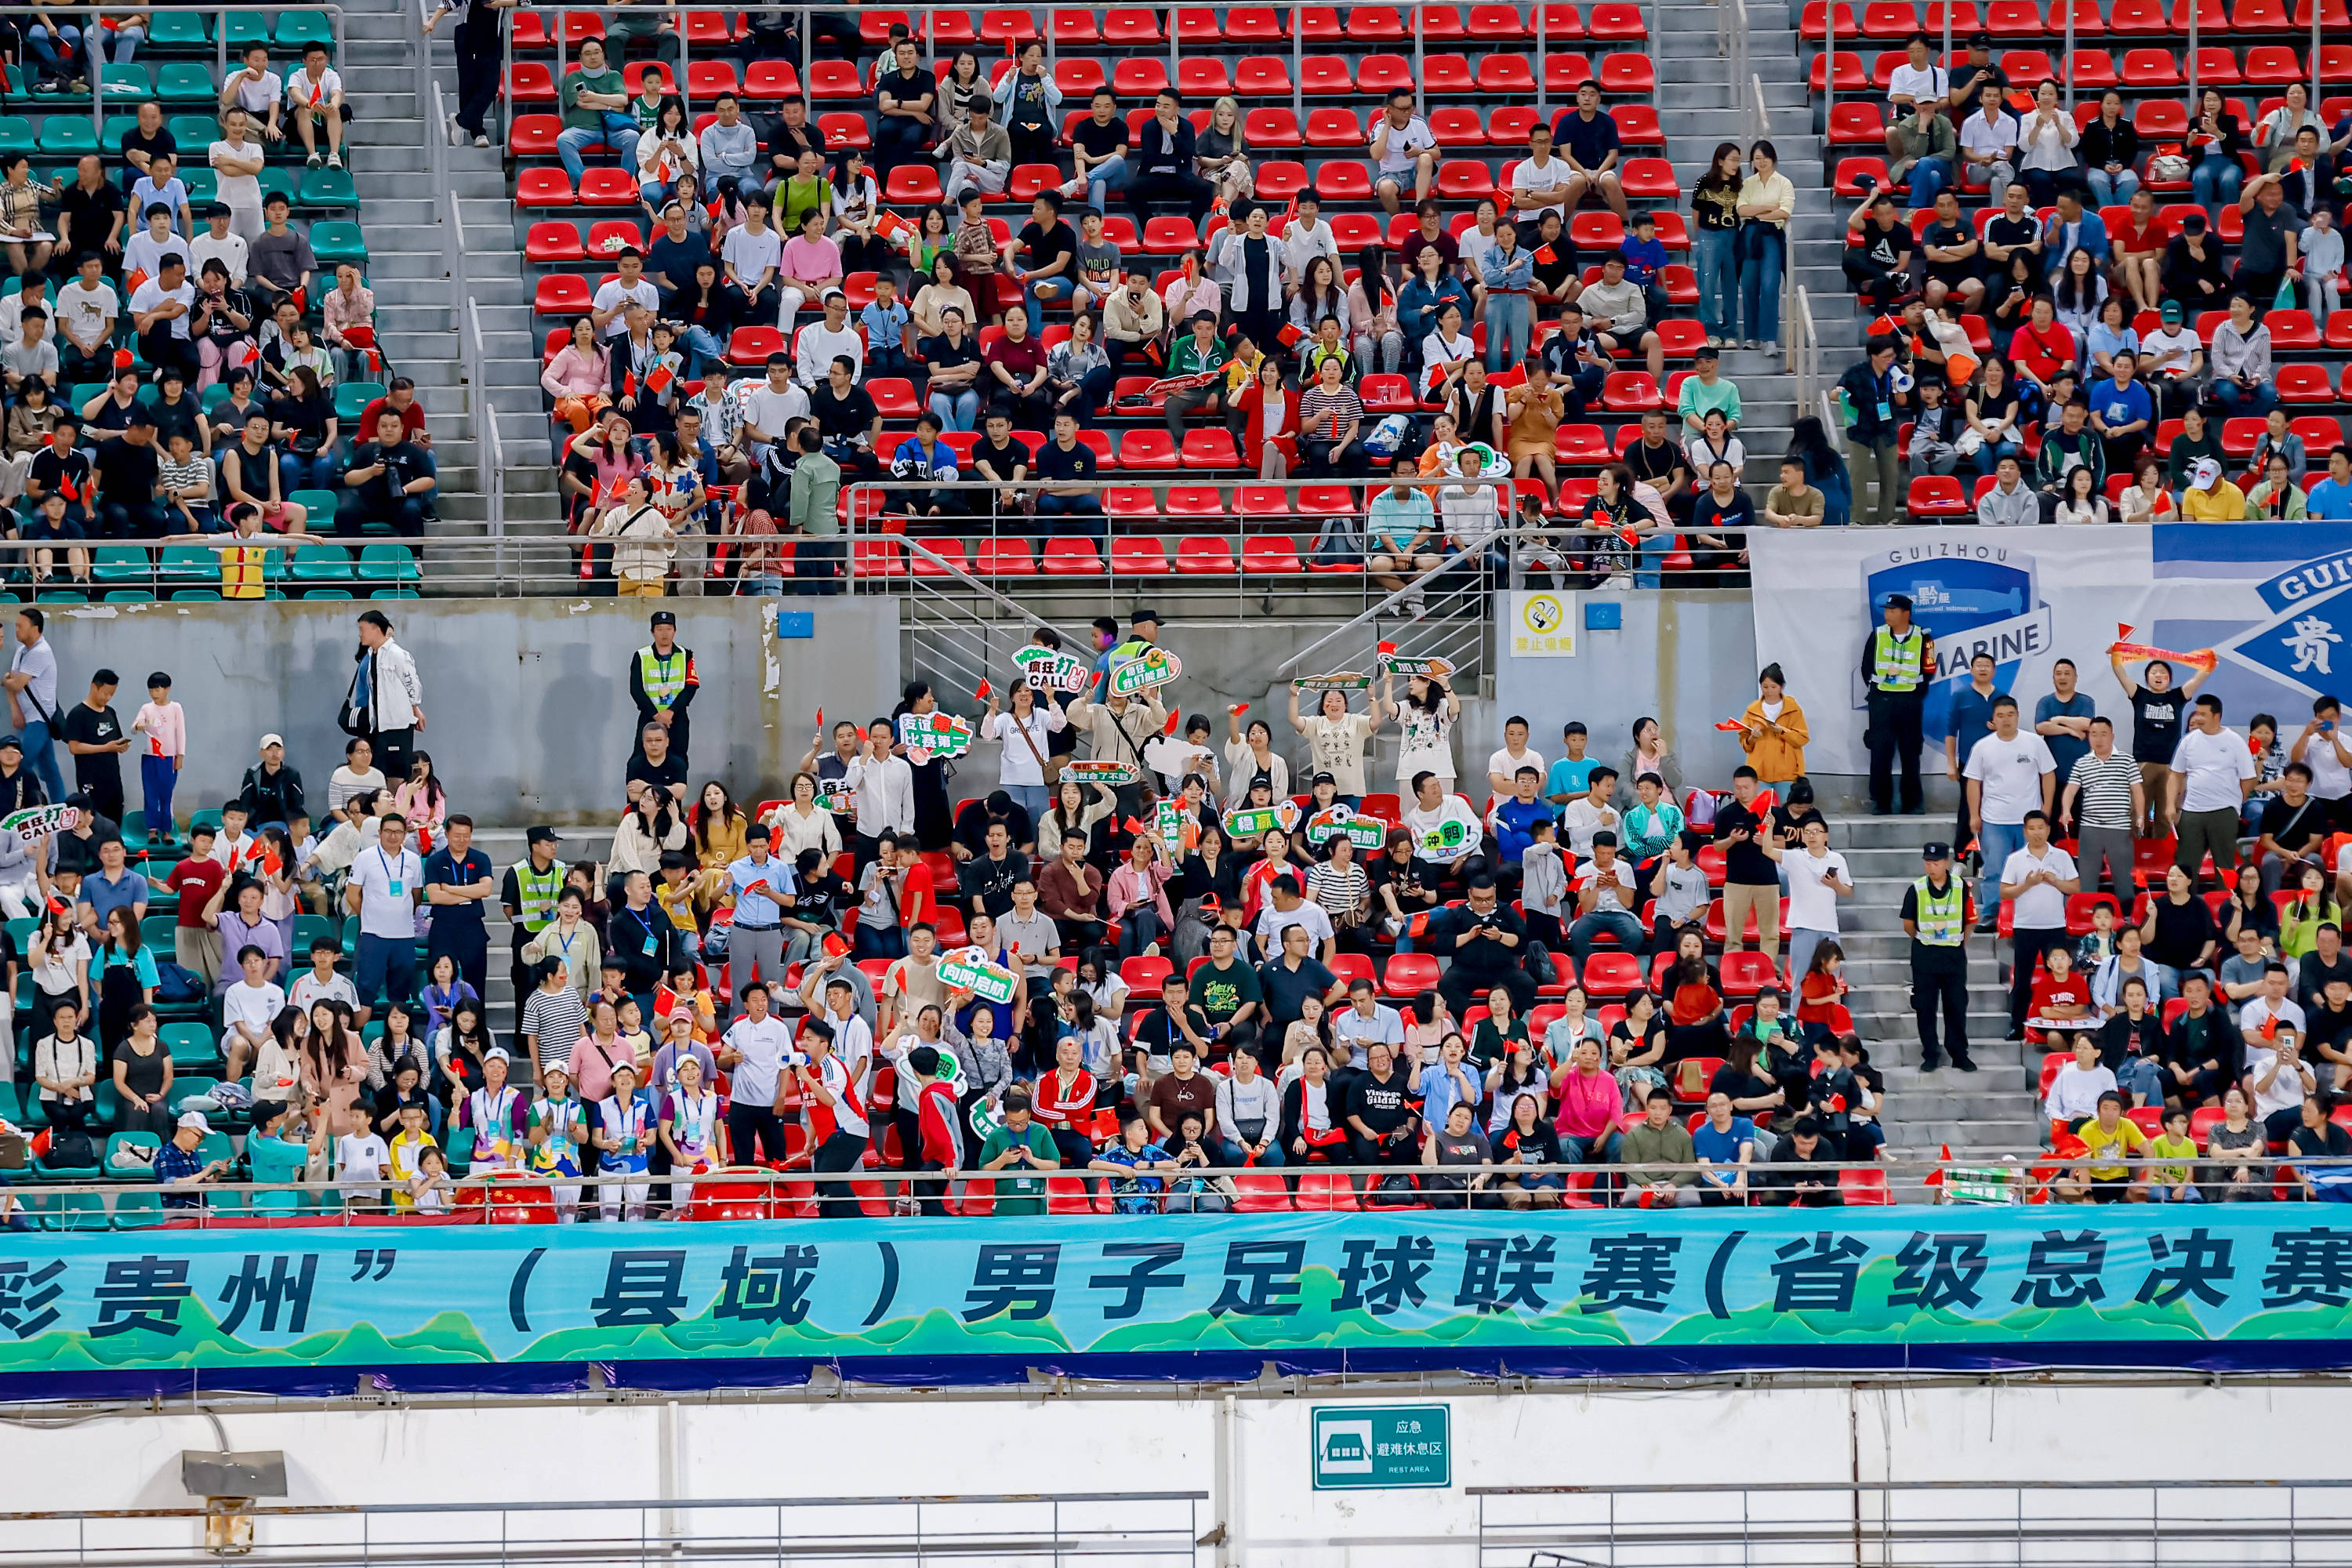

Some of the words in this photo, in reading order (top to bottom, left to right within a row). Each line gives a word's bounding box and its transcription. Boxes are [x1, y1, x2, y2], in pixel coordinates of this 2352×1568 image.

[1889, 543, 2007, 563] GUIZHOU
[2278, 556, 2352, 600] GUI
[2281, 615, 2343, 674] 贵
[1123, 666, 1167, 690] 我们能赢
[1397, 662, 1432, 675] 加油
[1029, 675, 1065, 688] CALL
[902, 713, 971, 735] 友谊第一
[904, 731, 966, 749] 比赛第二
[22, 822, 60, 840] CALL
[1237, 813, 1272, 832] 稳赢
[942, 964, 1007, 999] 向阳启航
[1396, 1420, 1422, 1434] 应急
[1376, 1441, 1443, 1457] 避难休息区
